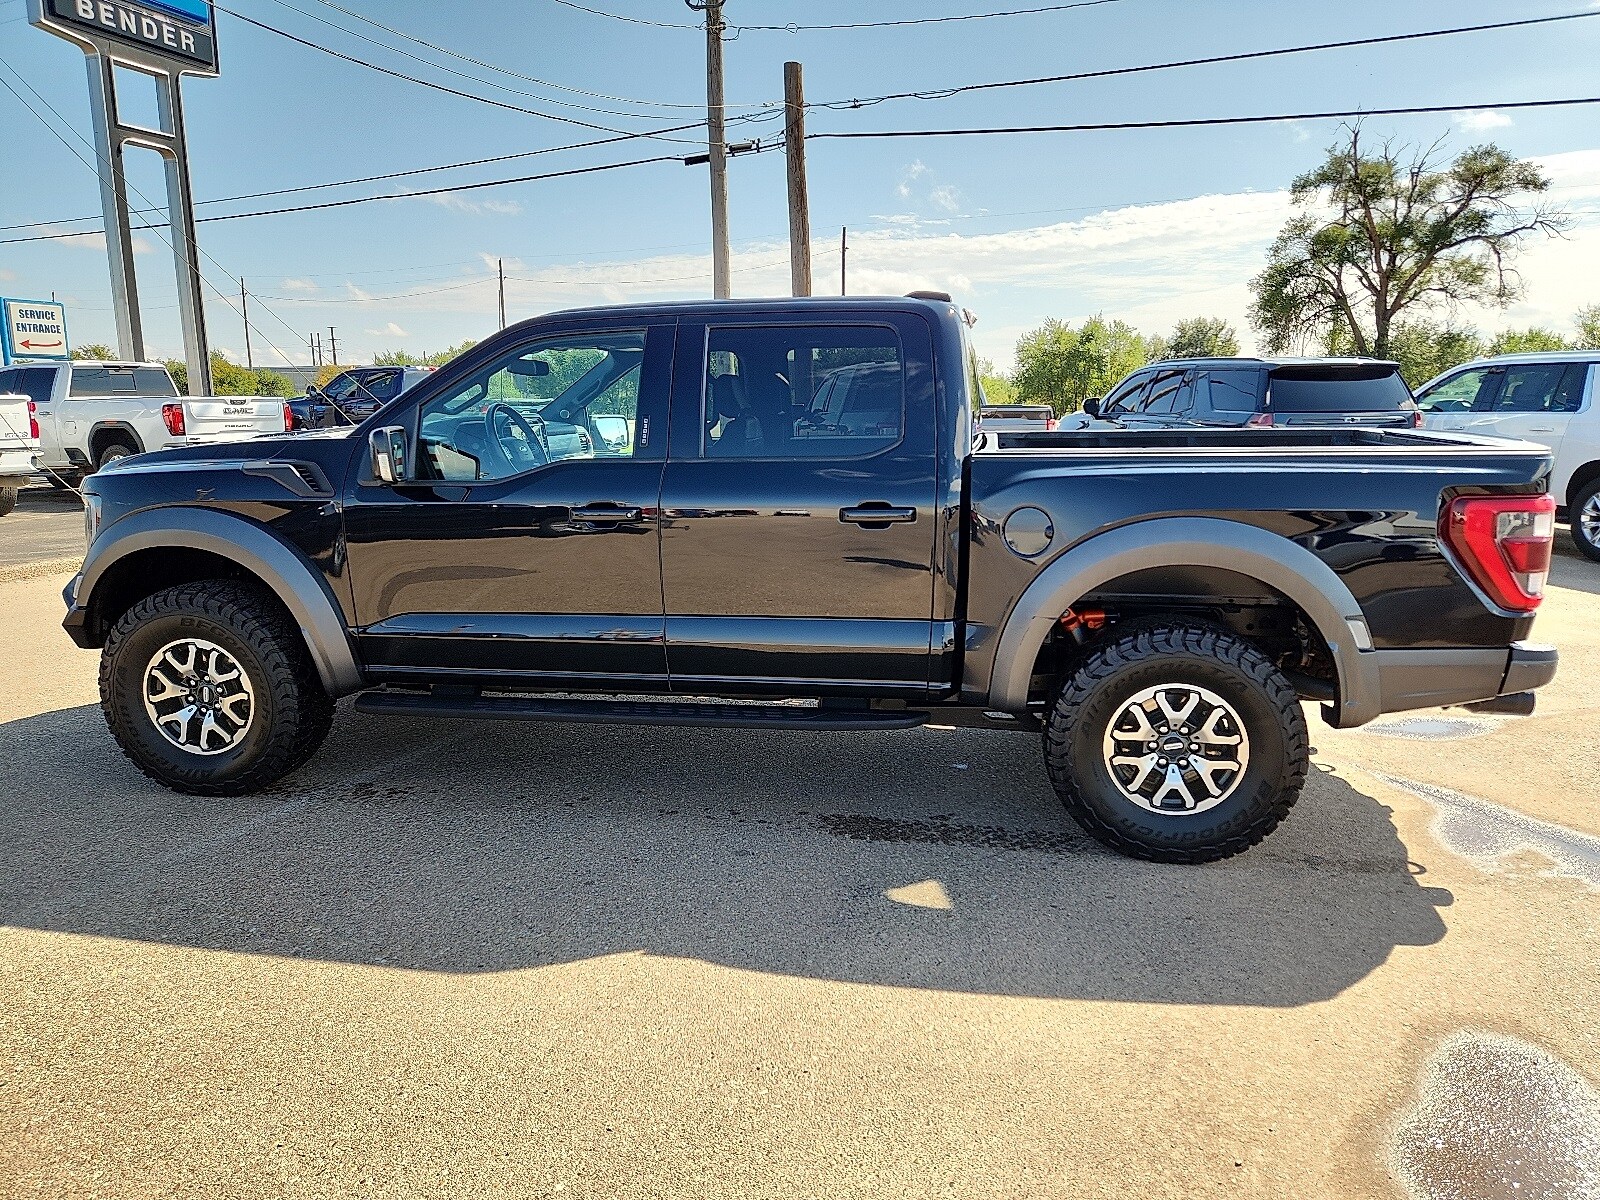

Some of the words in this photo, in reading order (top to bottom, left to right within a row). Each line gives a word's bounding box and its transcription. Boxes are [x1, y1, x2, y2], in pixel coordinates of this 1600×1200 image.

[76, 0, 196, 53] BENDER
[18, 308, 56, 321] SERVICE
[15, 322, 62, 334] ENTRANCE
[222, 407, 254, 416] GMC
